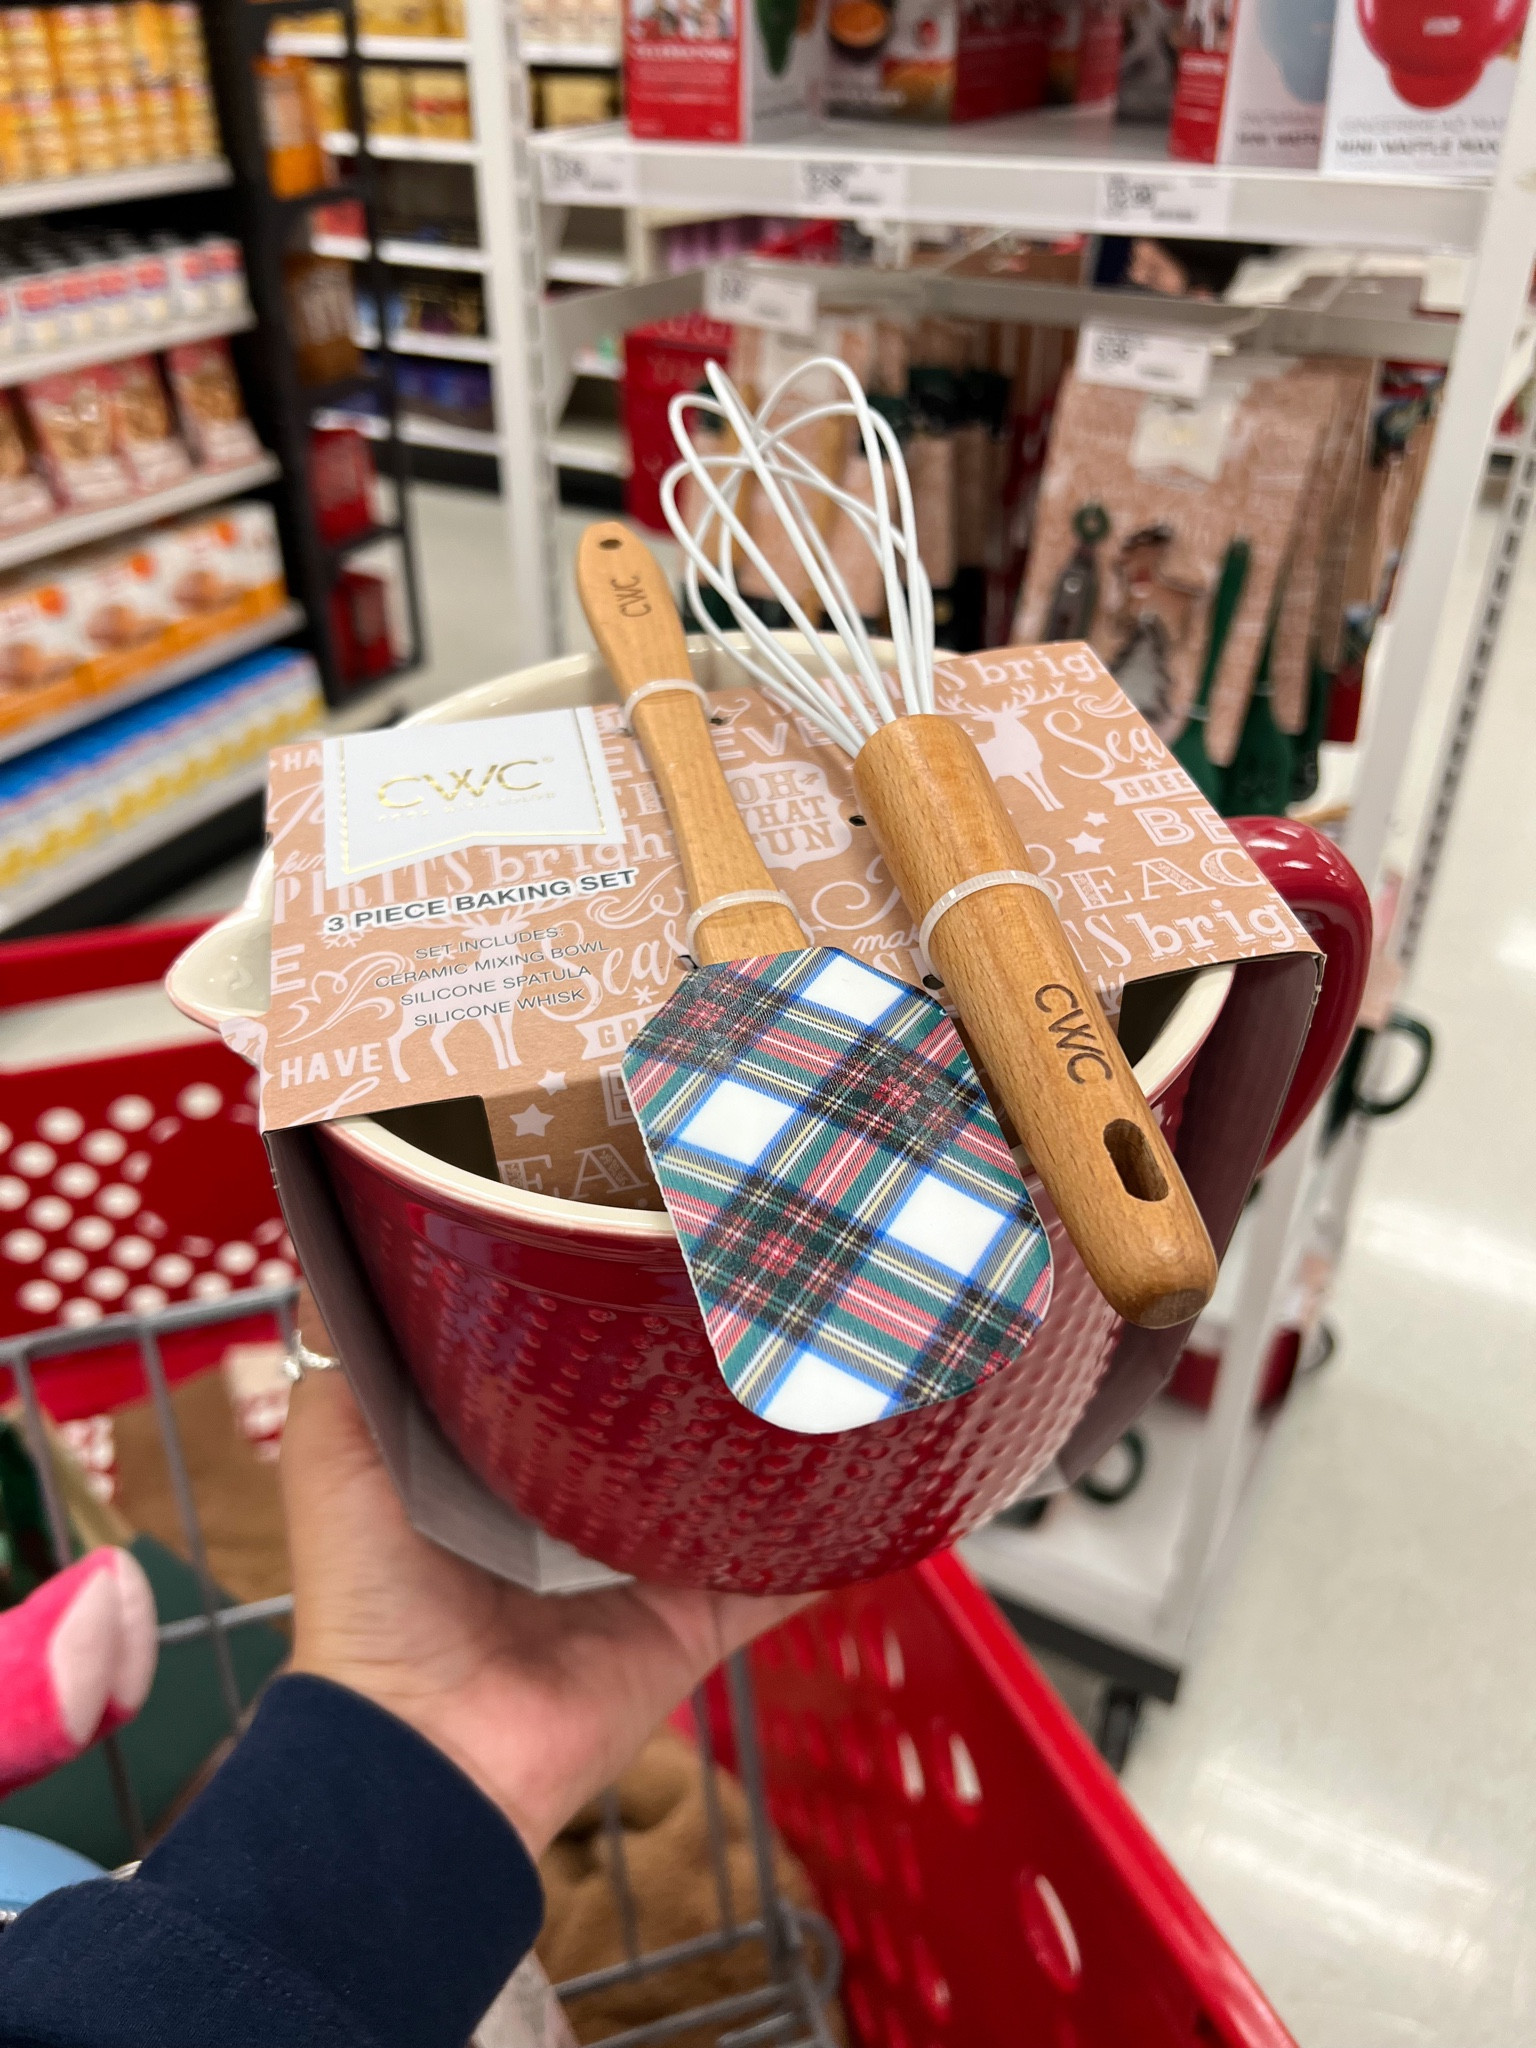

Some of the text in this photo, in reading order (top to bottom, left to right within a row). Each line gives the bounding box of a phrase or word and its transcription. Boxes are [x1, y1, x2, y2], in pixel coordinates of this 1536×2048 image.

[610, 574, 653, 618] CWC
[377, 760, 543, 809] CWC
[326, 869, 636, 933] 3 PIECE BAKING SET
[375, 939, 611, 989] CERAMIC MIXING BOWL
[415, 927, 565, 960] SET INCLUDES:
[401, 965, 592, 1007] SILICONE SPATULA
[413, 988, 586, 1028] SILICONE WHISK
[1034, 983, 1113, 1085] CWC
[280, 1042, 384, 1090] HAVE
